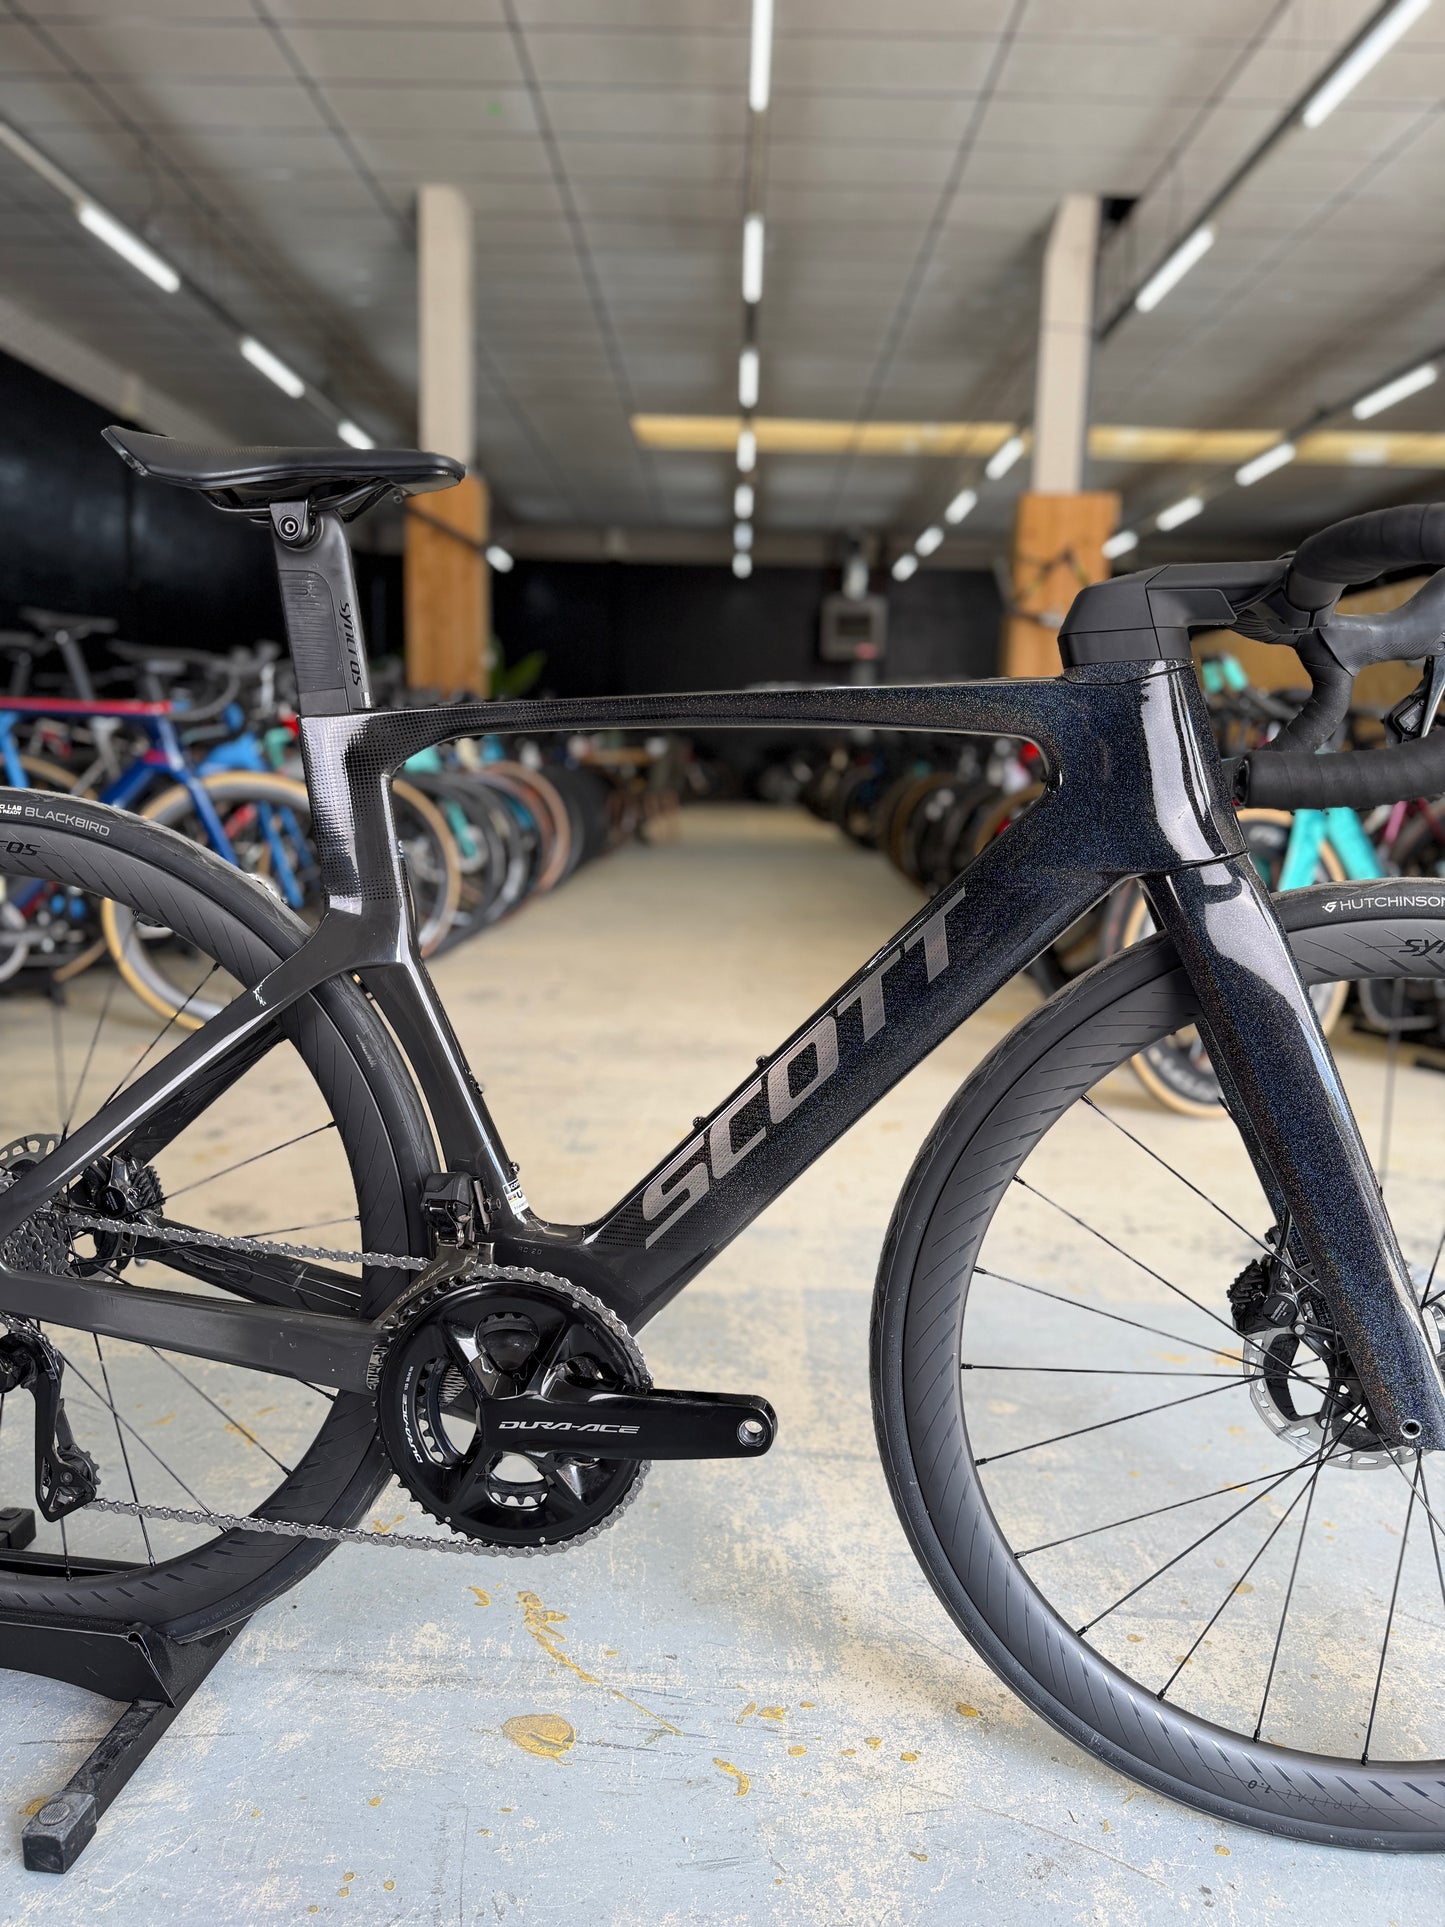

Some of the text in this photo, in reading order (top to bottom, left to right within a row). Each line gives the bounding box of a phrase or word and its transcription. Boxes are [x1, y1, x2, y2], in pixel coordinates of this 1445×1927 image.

[25, 806, 110, 837] BLACKBIRD
[642, 886, 967, 1250] SCOTT
[498, 1420, 641, 1435] DURA-ACE
